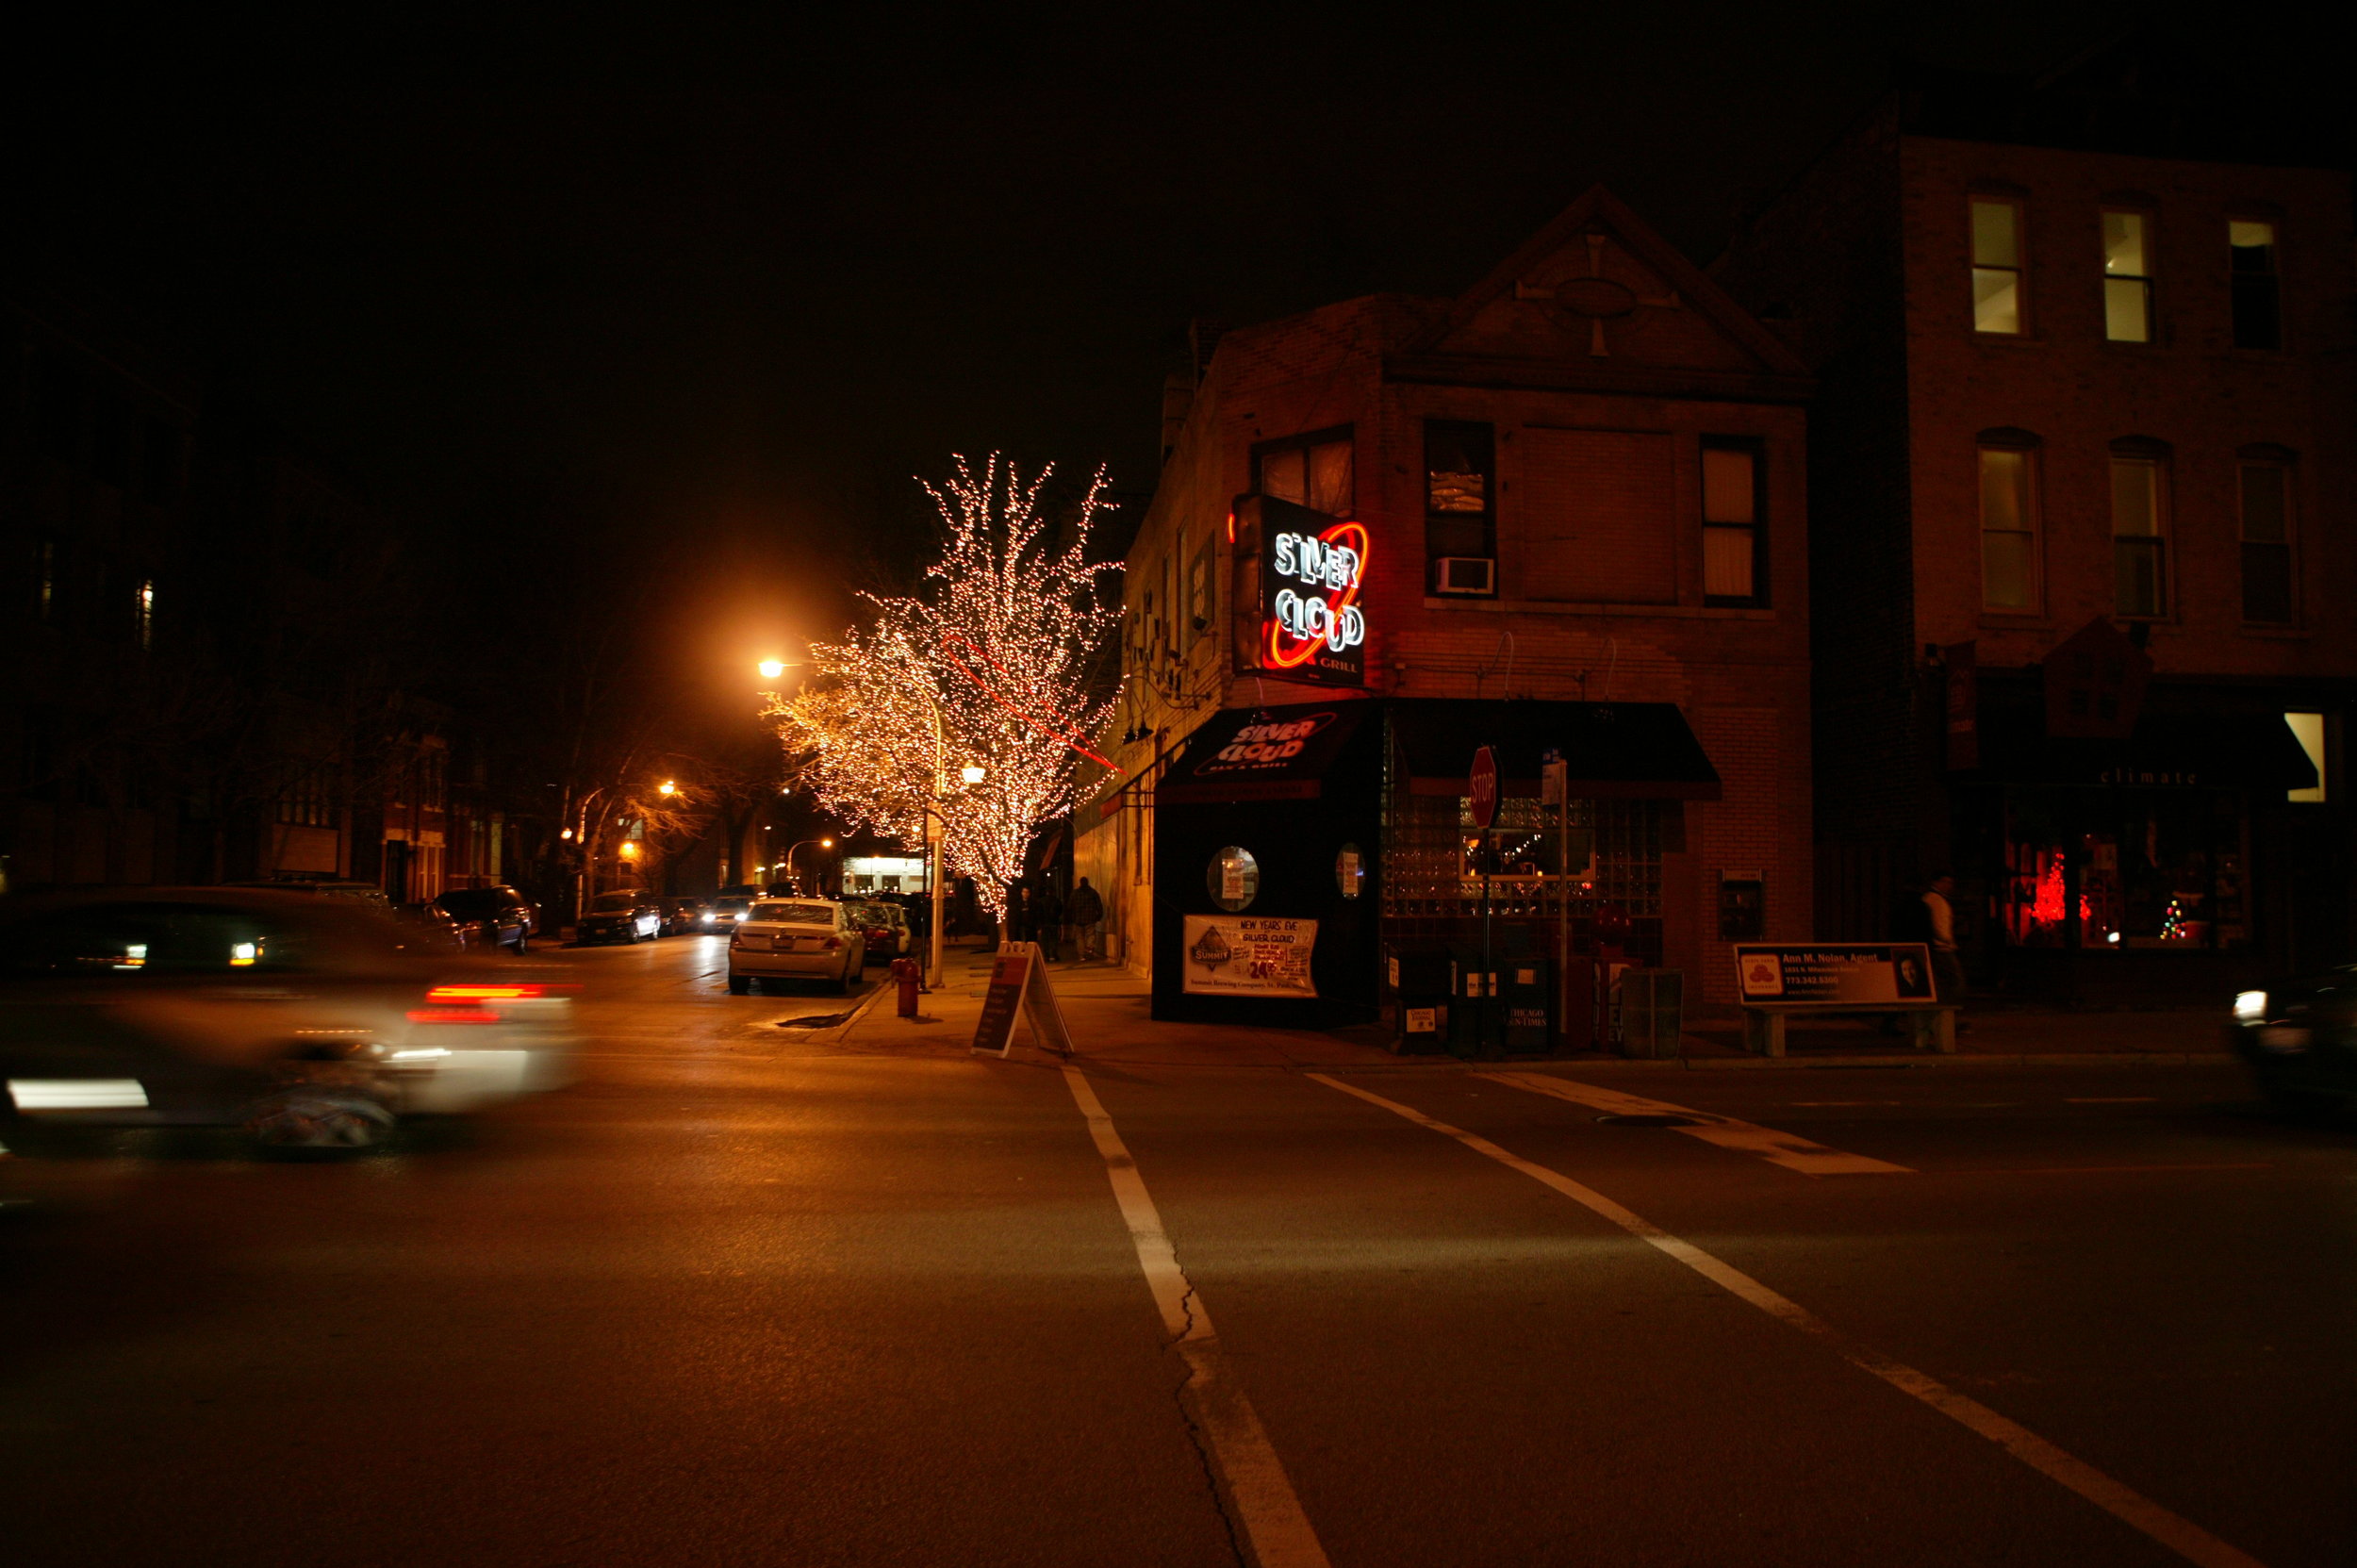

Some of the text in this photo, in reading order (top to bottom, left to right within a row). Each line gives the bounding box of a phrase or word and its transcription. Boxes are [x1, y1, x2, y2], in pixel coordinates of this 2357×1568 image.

[1275, 588, 1365, 652] CLOUD
[1320, 657, 1359, 673] GRILL
[1230, 719, 1316, 743] SILVER
[1217, 739, 1306, 763] CLOUD
[2099, 766, 2198, 784] climate
[1472, 771, 1494, 804] STOP
[1241, 919, 1257, 930] NEW
[1284, 921, 1298, 932] EVE
[1243, 933, 1295, 944] SILVER CLOUD
[1195, 949, 1229, 960] SUMMIT
[1783, 953, 1878, 965] Ann M. Nolan, Agent
[1509, 1008, 1544, 1017] CHICAGO
